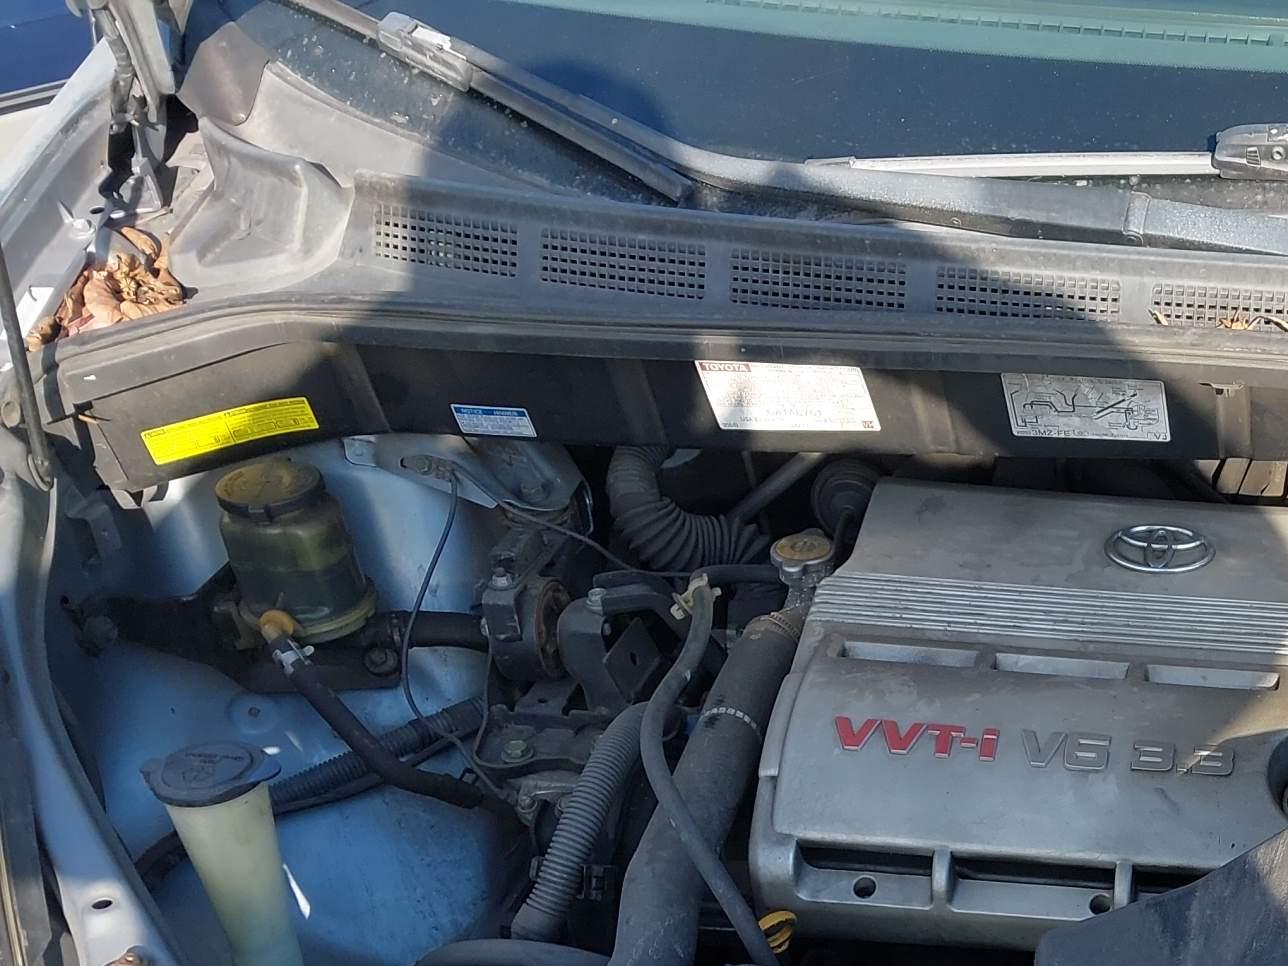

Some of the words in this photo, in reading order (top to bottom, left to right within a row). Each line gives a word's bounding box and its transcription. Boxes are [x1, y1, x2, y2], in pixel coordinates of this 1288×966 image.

[700, 362, 748, 372] TOYOTA
[1021, 728, 1112, 771] V6
[1130, 742, 1236, 776] 3.3
